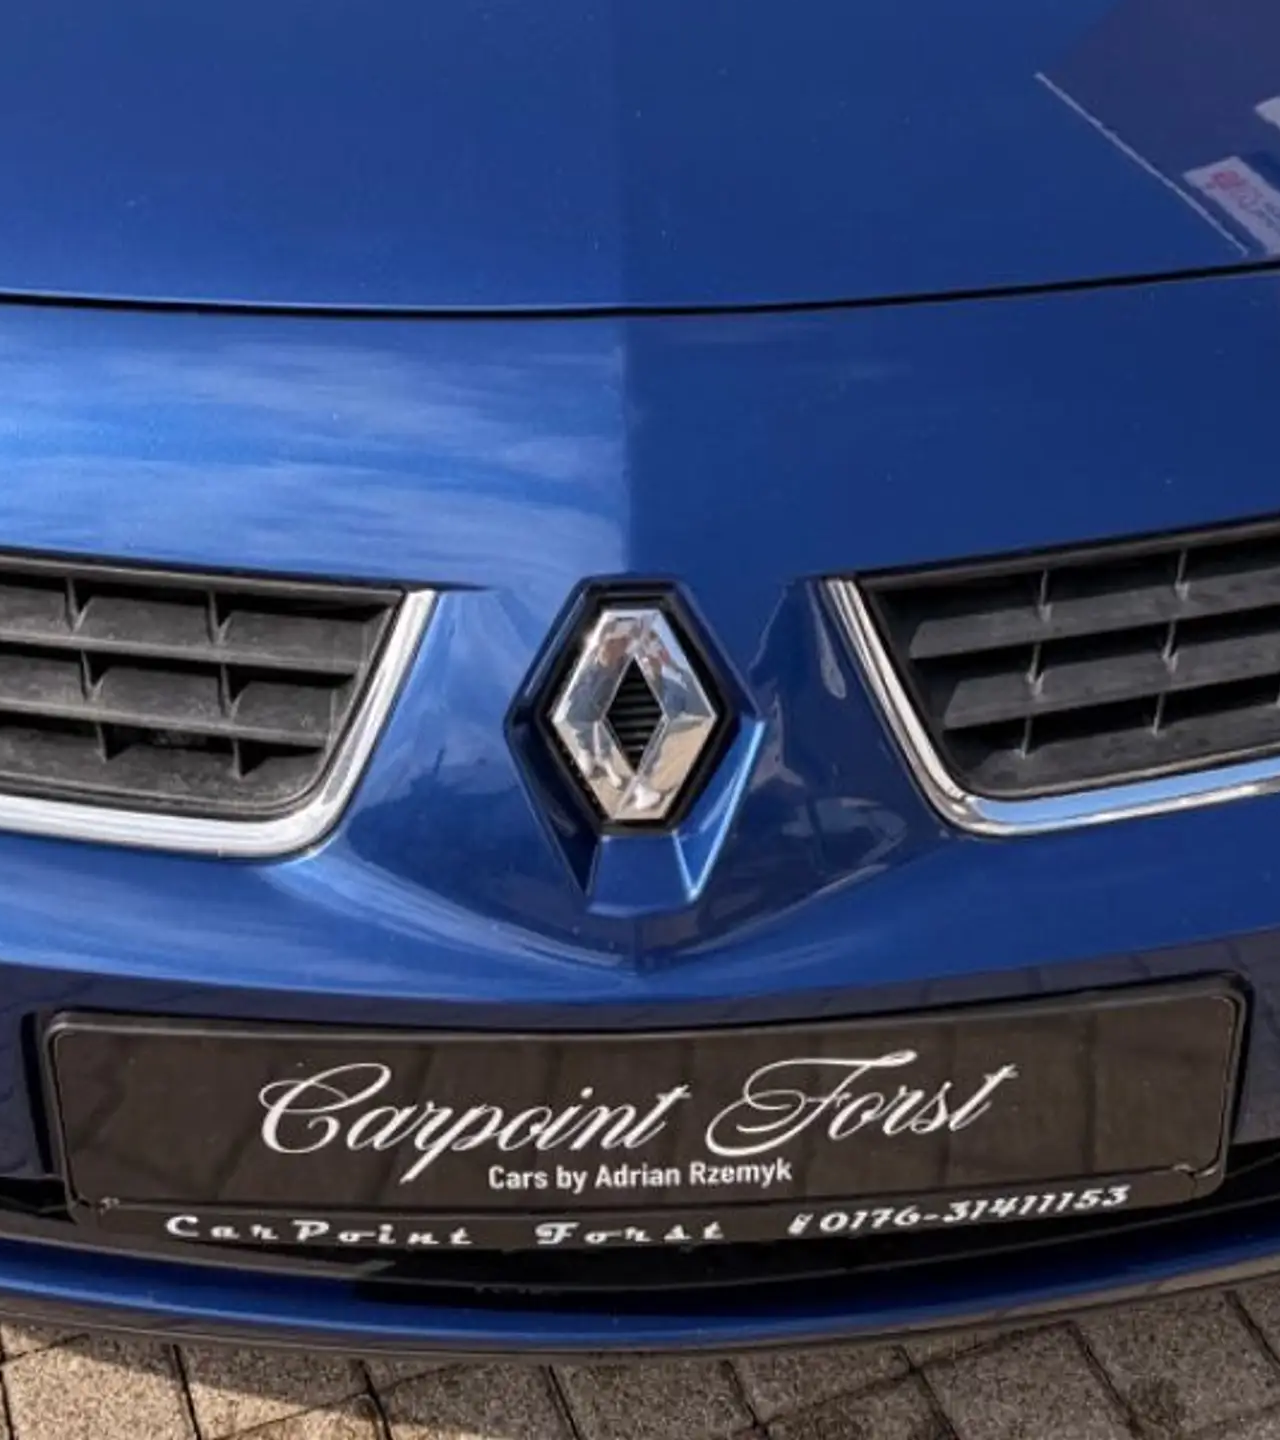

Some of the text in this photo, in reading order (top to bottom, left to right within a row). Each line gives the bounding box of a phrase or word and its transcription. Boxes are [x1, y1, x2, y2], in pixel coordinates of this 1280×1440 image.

[258, 1049, 1019, 1185] Carpoint Forst
[487, 1157, 793, 1195] Cars by Adrian Rzemyk
